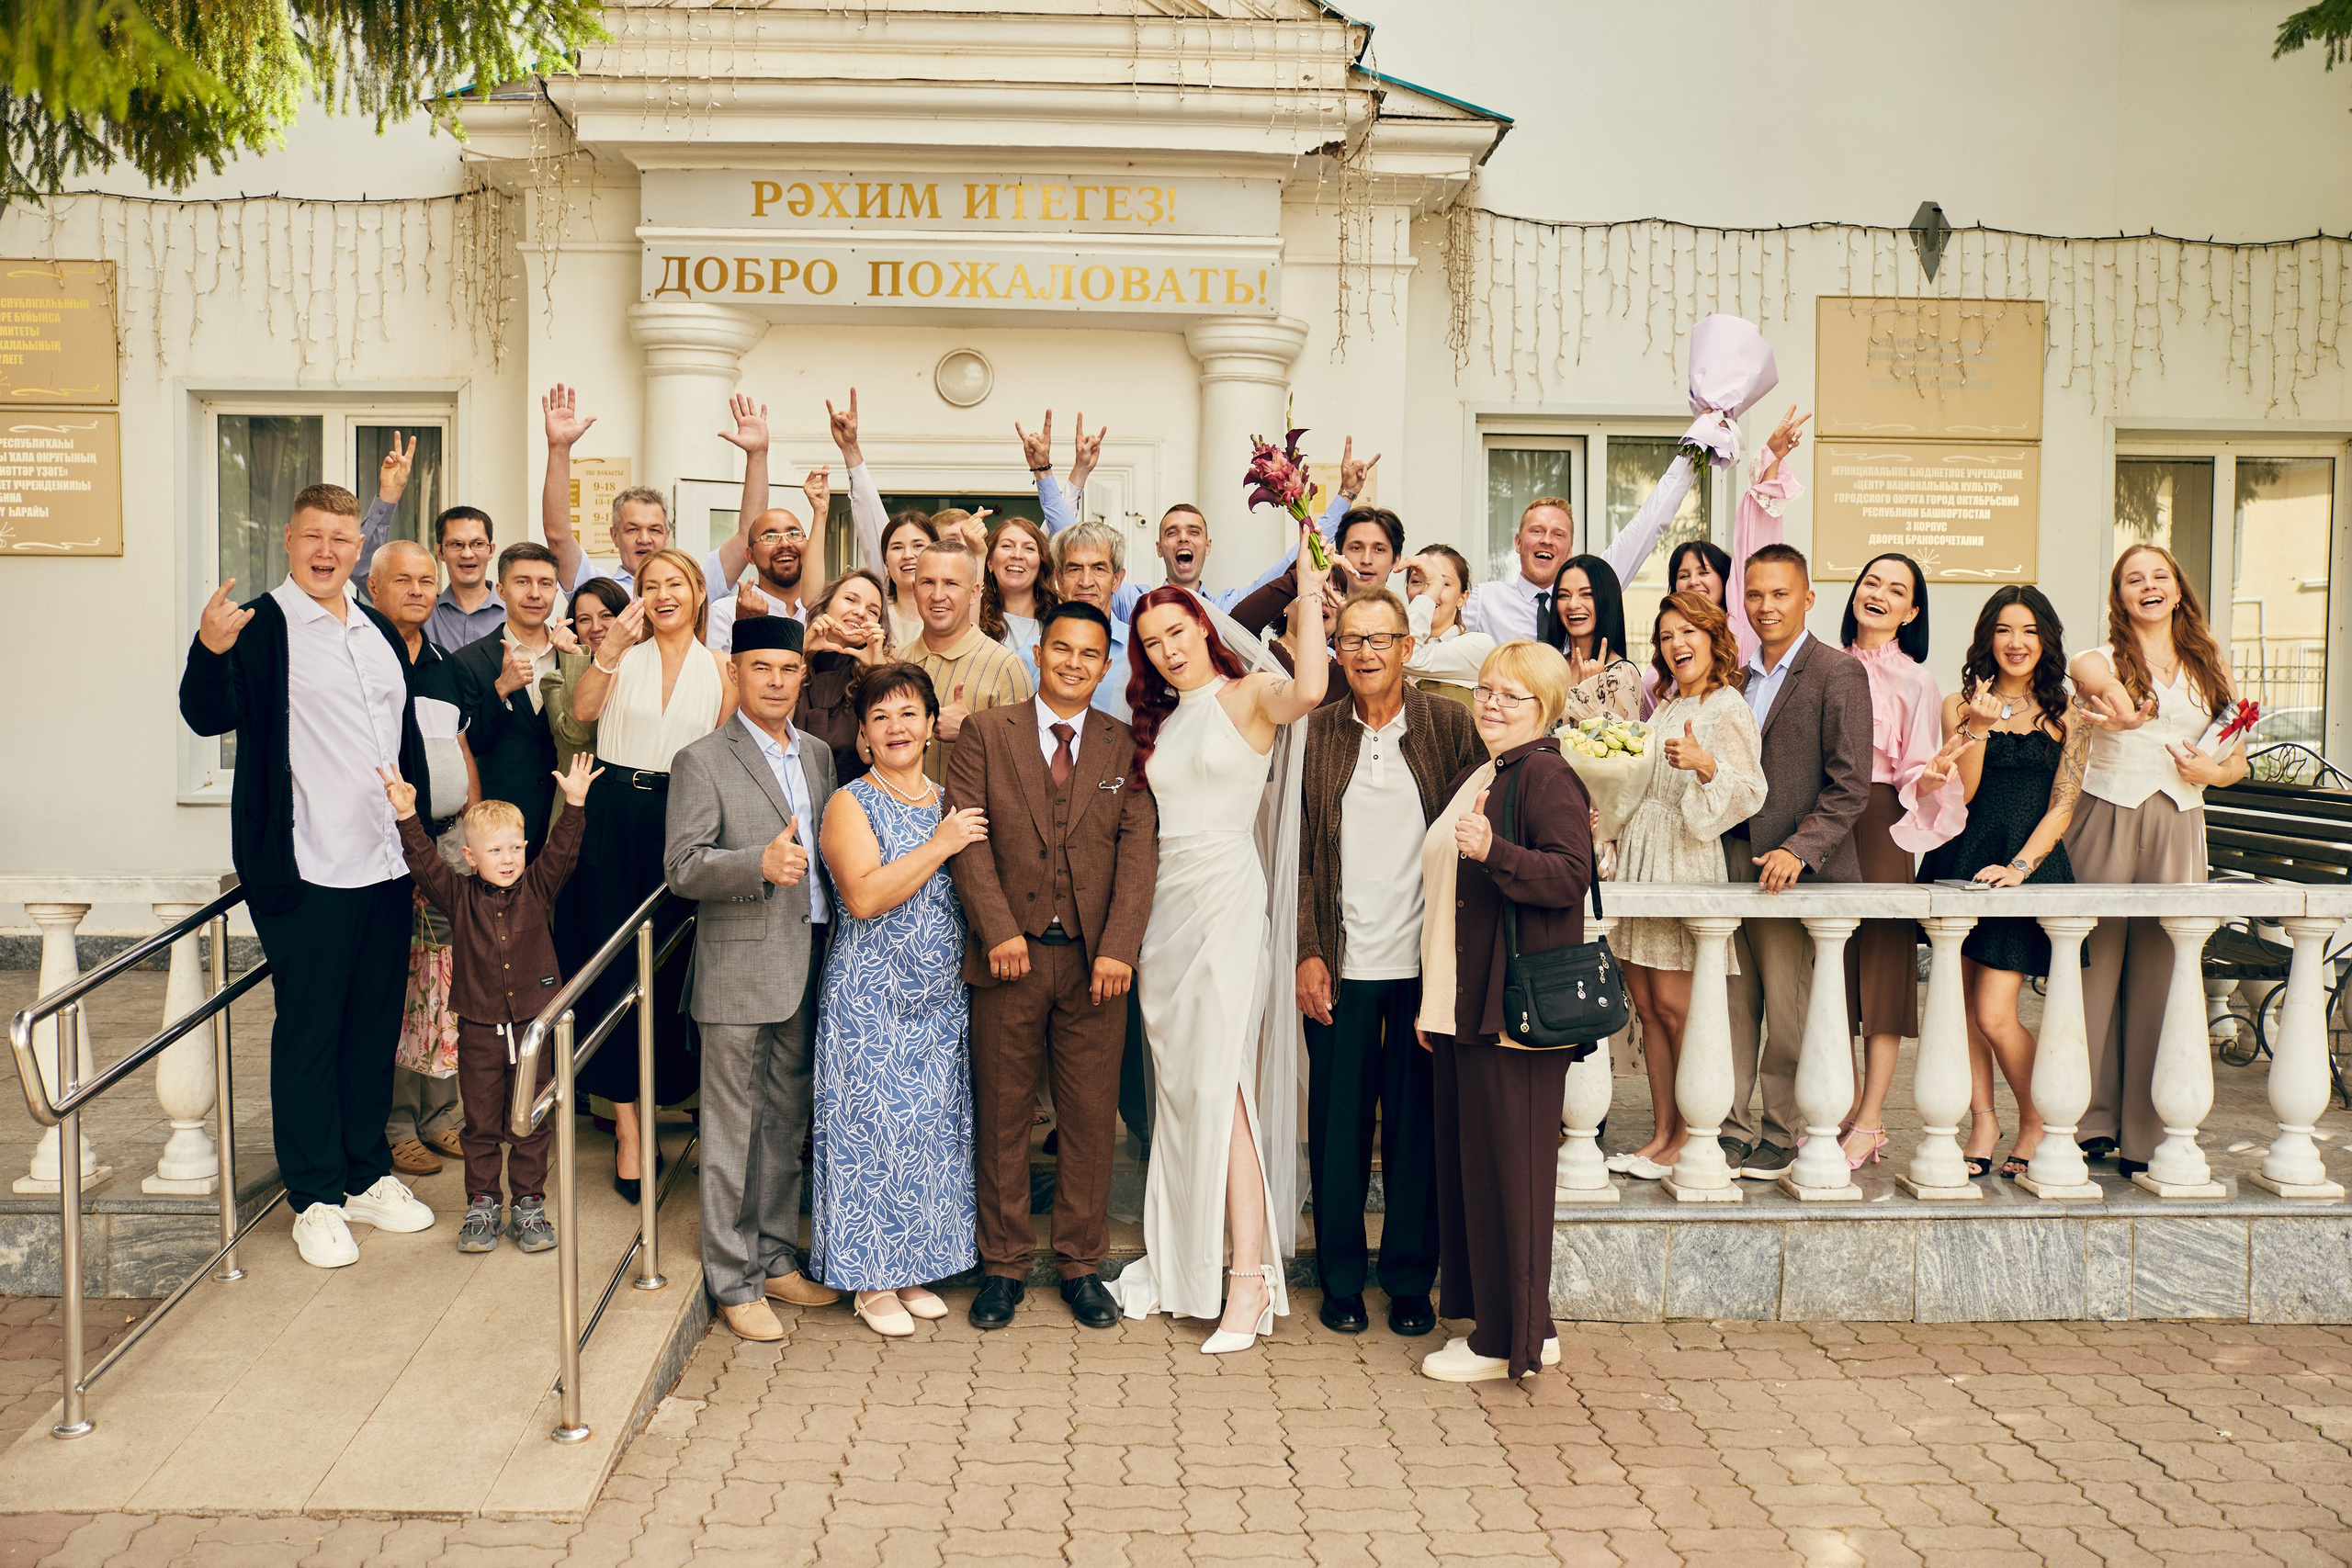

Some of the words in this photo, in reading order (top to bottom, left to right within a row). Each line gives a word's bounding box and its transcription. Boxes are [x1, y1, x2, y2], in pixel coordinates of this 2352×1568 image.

[752, 181, 943, 219] РӘХИМ
[963, 184, 1176, 227] ИТЕГЕҘ!
[654, 256, 838, 300] ДОБРО
[867, 260, 1268, 305] ПОЖАЛОВАТЬ!
[1832, 466, 1908, 478] МУНИЦИПАЛЬНОЕ
[1910, 467, 1965, 479] БЮДЖЕТНОЕ
[1967, 468, 2023, 480] УЧРЕЖДЕНИЕ
[594, 482, 616, 491] 9-18
[1886, 480, 1960, 491] НАЦИОНАЛЬНЫХ
[1835, 492, 1892, 504] ГОРОДСКОГО
[1893, 493, 1925, 504] ОКРУГА
[1926, 494, 1955, 506] ГОРОД
[1956, 494, 2019, 506] ОКТЯБРЬСКИЙ
[594, 513, 613, 522] 9-1
[1862, 507, 1919, 518] РЕСПУБЛИКИ
[1920, 508, 1991, 520] БАШКОРТОСТАН
[1913, 521, 1948, 532] КОРПУС
[1868, 534, 1904, 546] ДВОРЕЦ
[1905, 535, 1984, 547] БРАКОСОЧЕТАНИЯ
